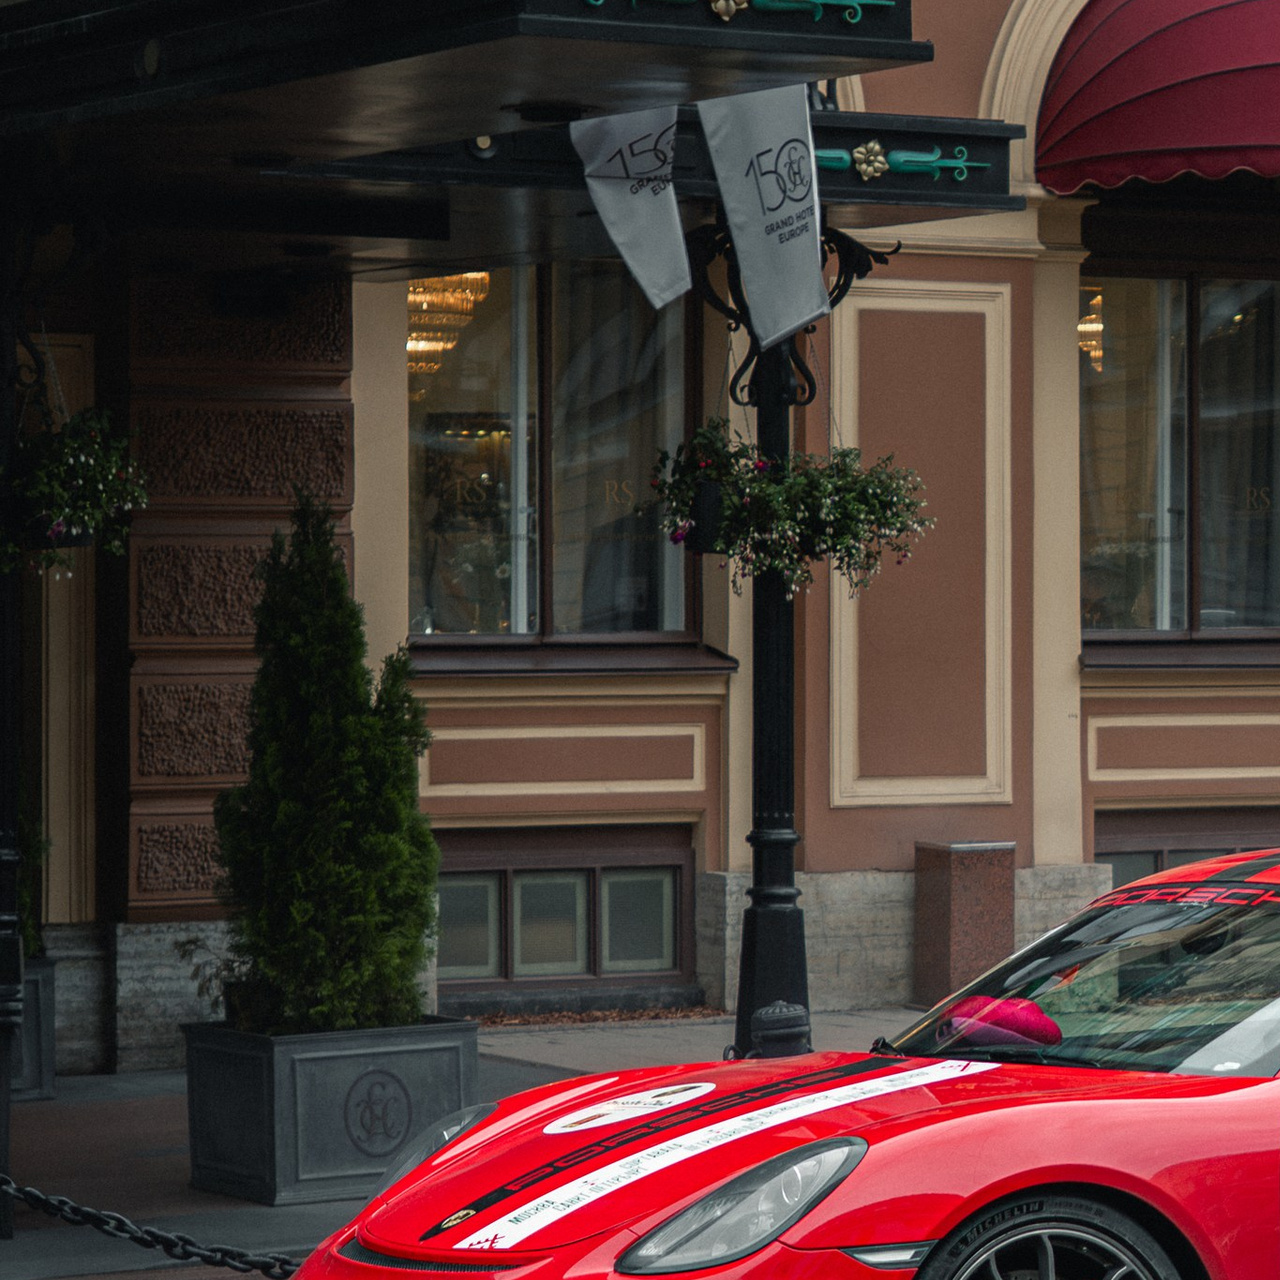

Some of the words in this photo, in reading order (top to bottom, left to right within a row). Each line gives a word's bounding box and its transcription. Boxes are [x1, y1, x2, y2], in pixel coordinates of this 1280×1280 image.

[765, 216, 795, 235] GRAND
[796, 205, 814, 222] HOTE
[778, 222, 810, 244] EUROPE
[604, 480, 635, 505] RS
[1246, 487, 1272, 510] RS
[505, 1072, 844, 1191] PORSCHE
[508, 1200, 557, 1226] МОСКВА
[966, 1202, 1040, 1243] MICHELIN
